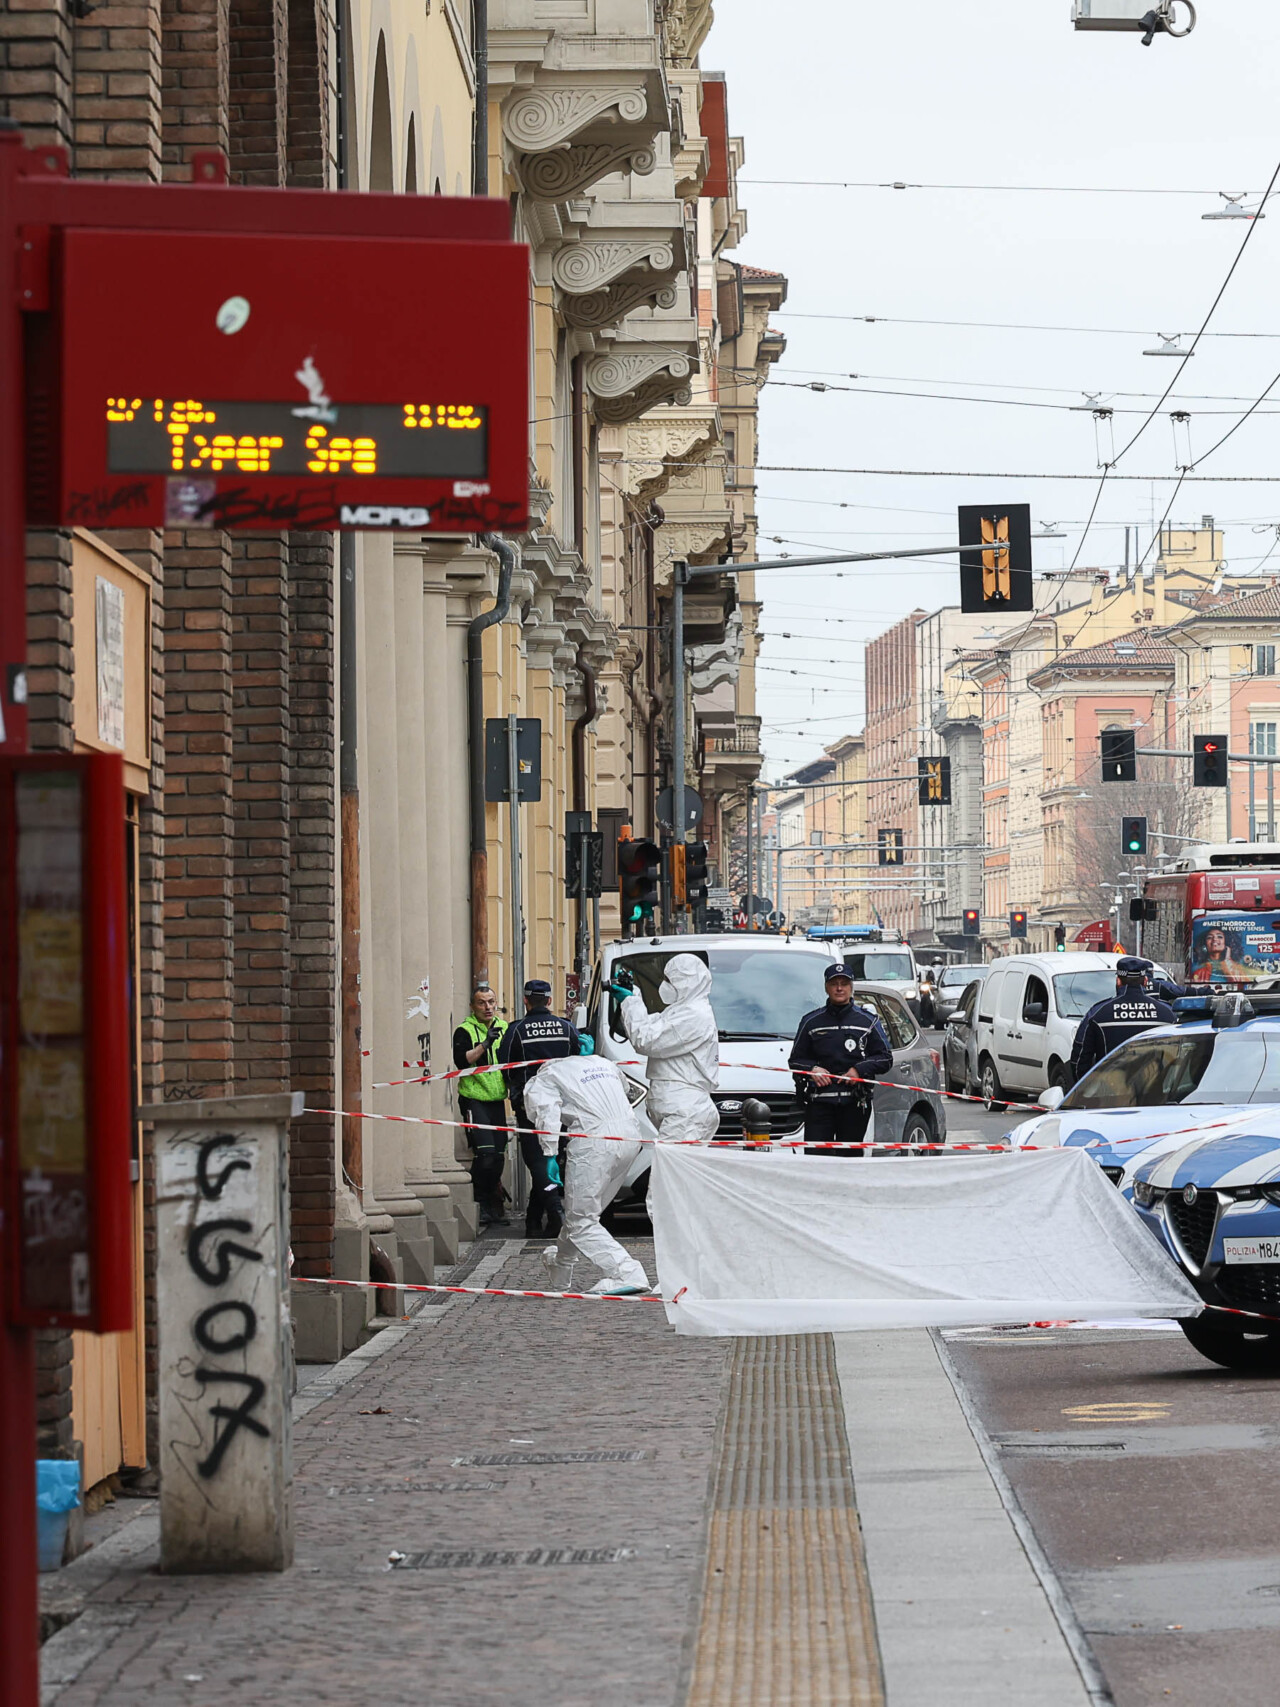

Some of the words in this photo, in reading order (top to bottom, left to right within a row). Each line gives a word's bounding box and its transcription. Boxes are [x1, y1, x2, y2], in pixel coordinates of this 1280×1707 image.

[1258, 945, 1273, 953] 125
[1113, 1003, 1156, 1011] POLIZIA
[1113, 1011, 1158, 1019] LOCALE
[525, 1020, 562, 1029] POLIZIA
[526, 1028, 564, 1037] LOCALE
[719, 1100, 742, 1111] Ford
[1226, 1246, 1257, 1256] POLIZIA
